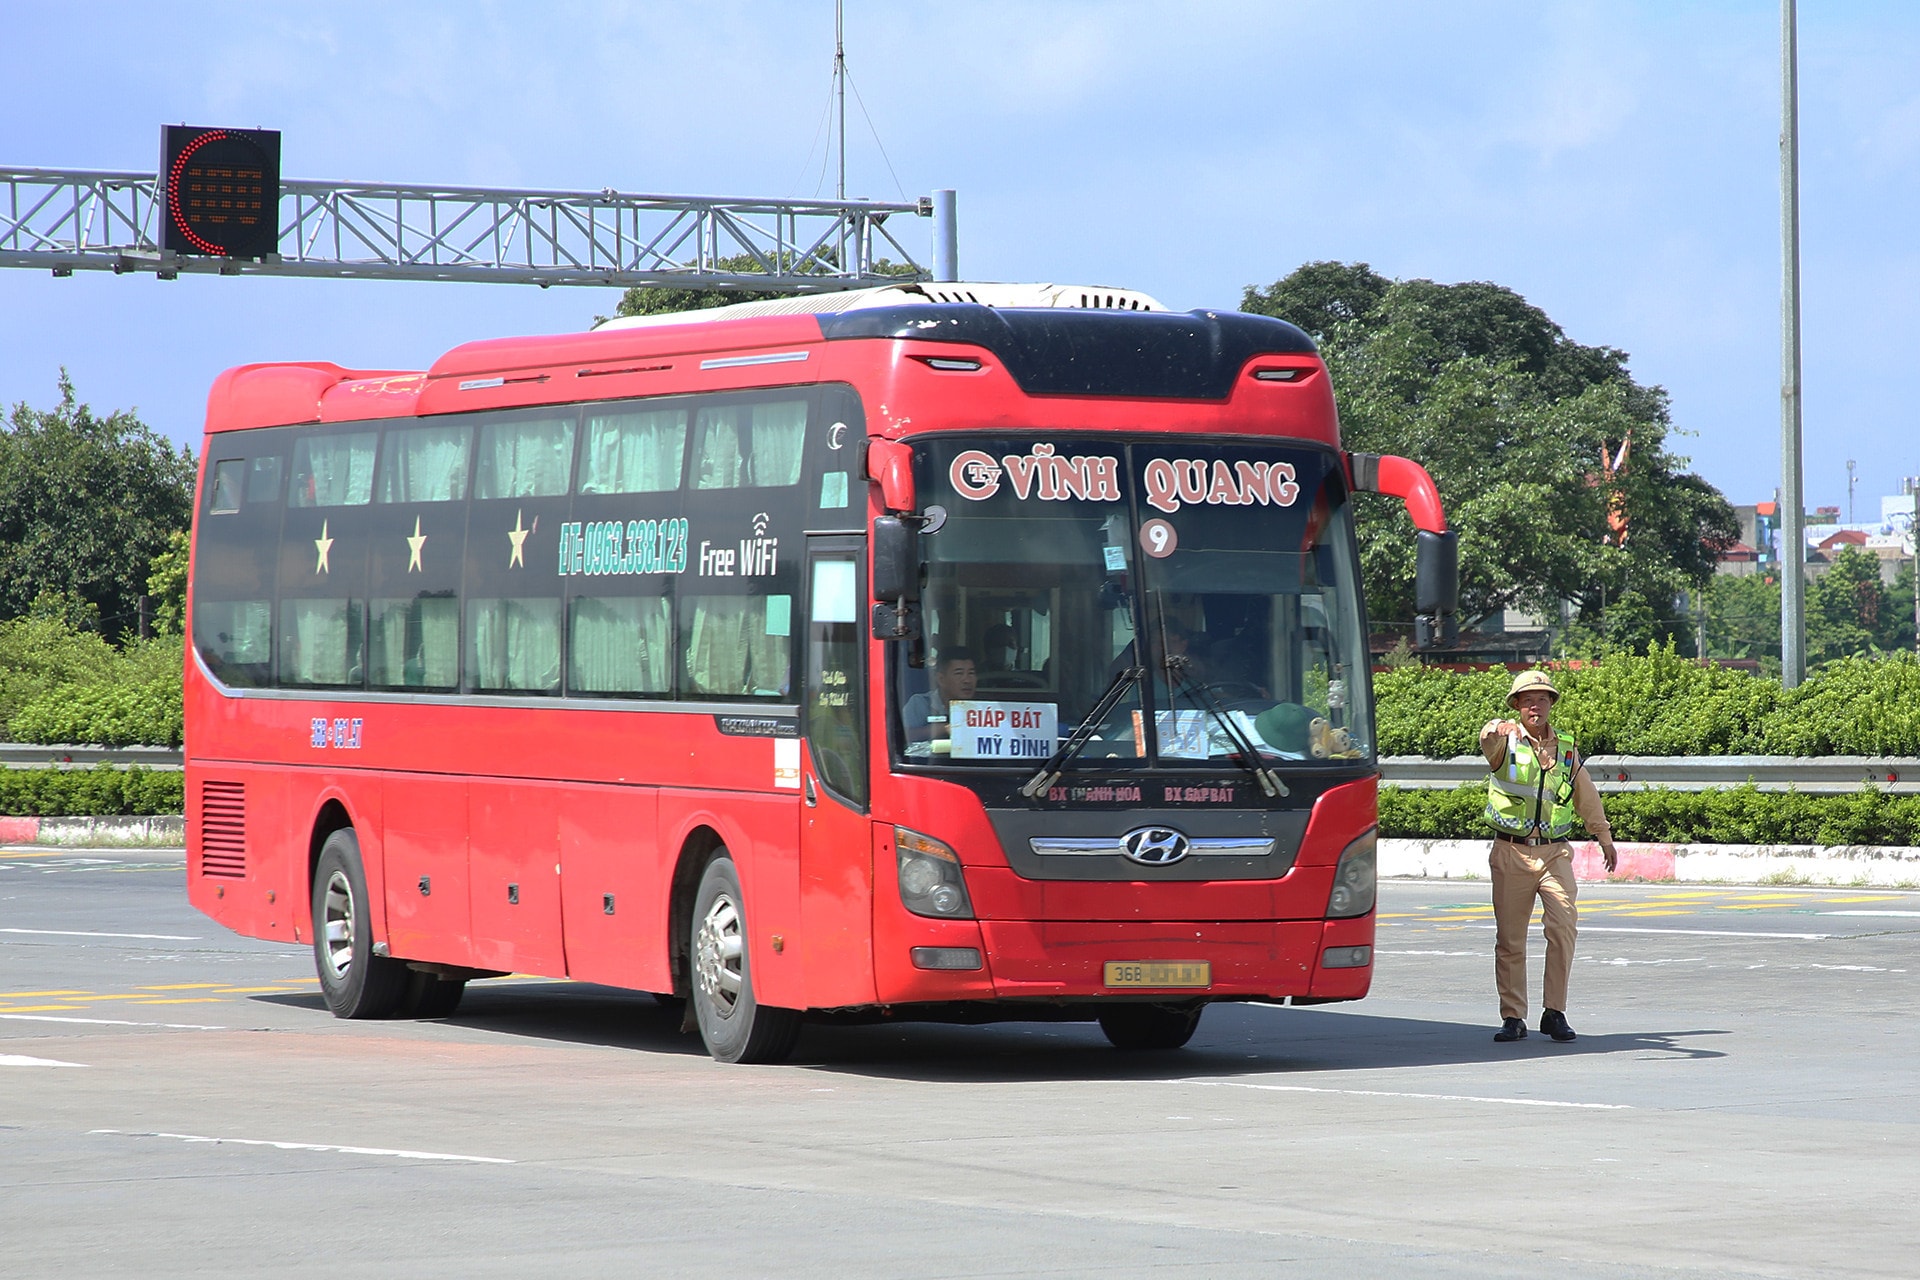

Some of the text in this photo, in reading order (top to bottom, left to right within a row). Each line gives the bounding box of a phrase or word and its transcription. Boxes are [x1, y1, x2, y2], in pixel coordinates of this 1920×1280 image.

[1002, 443, 1121, 501] VĨNH
[1144, 458, 1300, 513] QUANG
[1149, 525, 1169, 553] 9
[699, 537, 778, 577] Free WiFi
[966, 706, 1042, 729] GIÁP BÁT
[977, 733, 1050, 757] MỸ ĐÌNH
[1049, 786, 1068, 801] BX
[1164, 786, 1183, 802] BX
